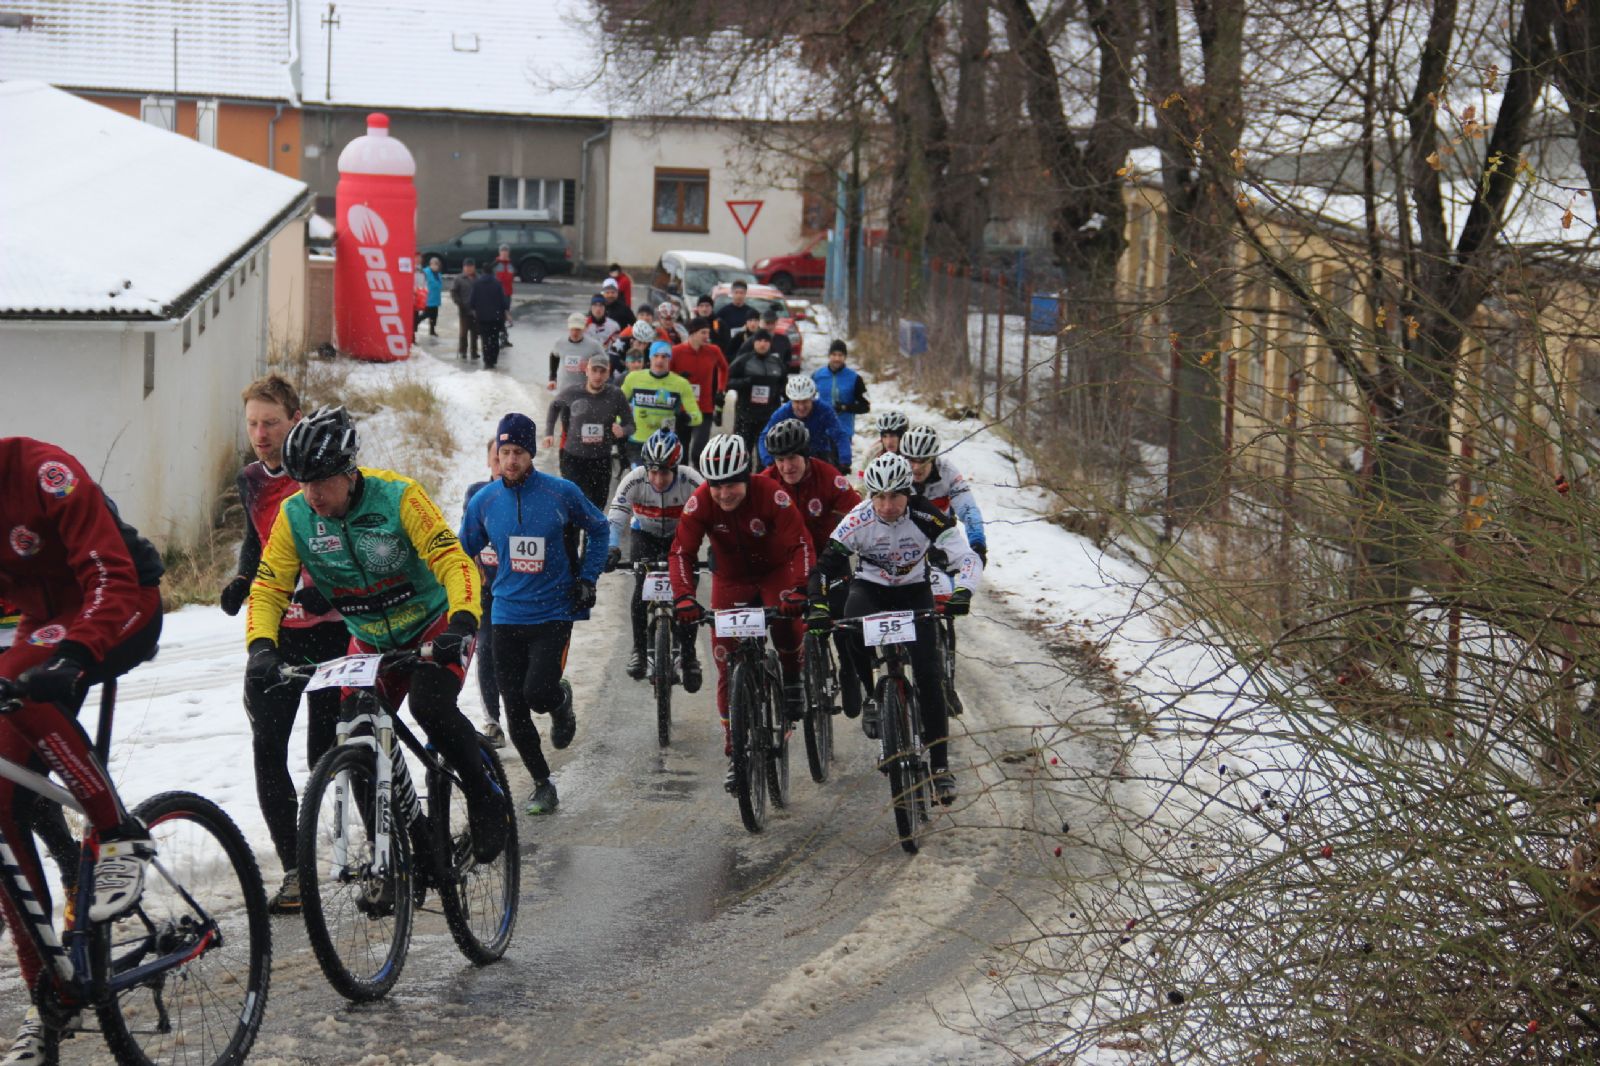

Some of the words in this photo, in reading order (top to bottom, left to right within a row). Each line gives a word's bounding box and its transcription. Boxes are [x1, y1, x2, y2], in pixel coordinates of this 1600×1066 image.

[588, 426, 599, 435] 12
[516, 541, 537, 556] 40
[511, 560, 543, 571] HOCH
[654, 580, 670, 592] 57
[729, 614, 750, 626] 17
[879, 620, 902, 633] 55
[322, 661, 366, 680] 112
